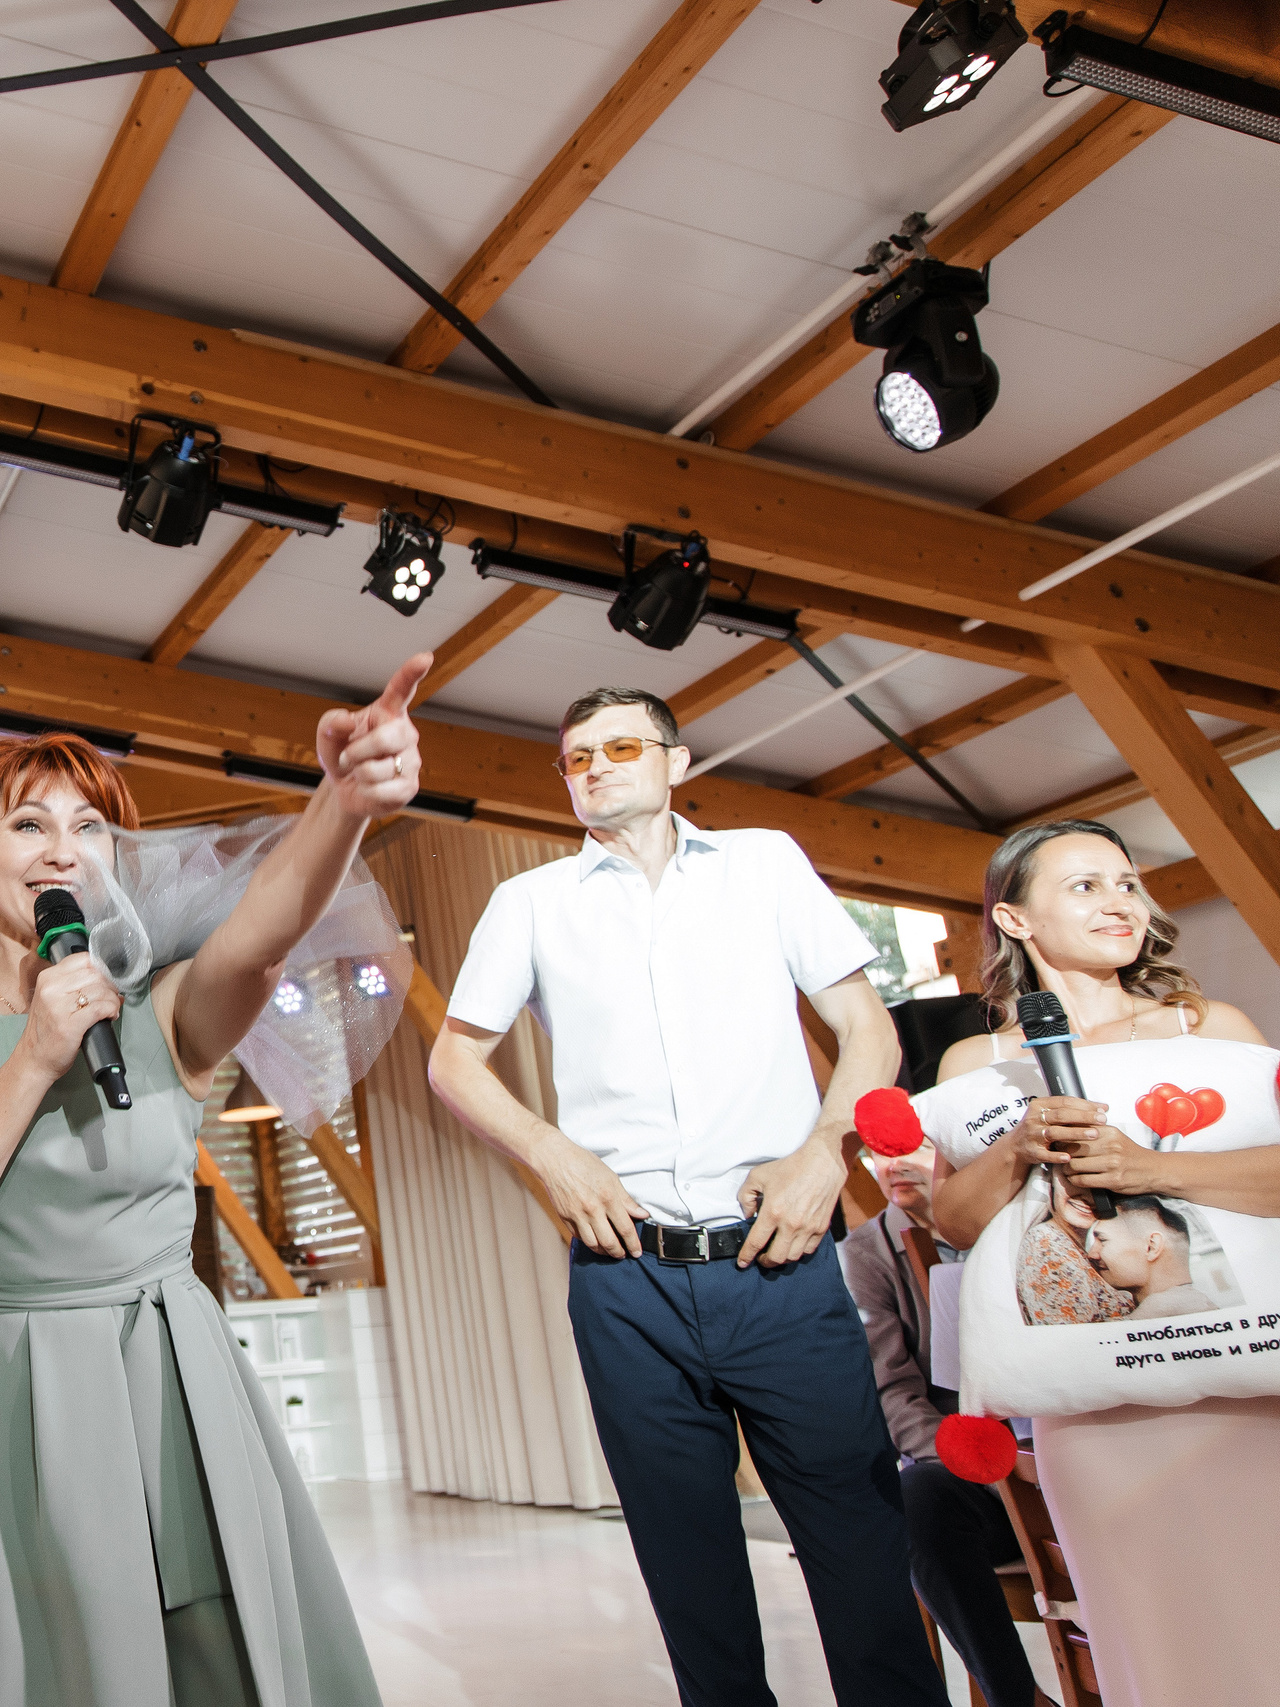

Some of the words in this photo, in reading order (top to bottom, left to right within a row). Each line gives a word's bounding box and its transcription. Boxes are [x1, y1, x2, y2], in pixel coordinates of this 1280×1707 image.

[965, 1104, 1009, 1137] Любовь
[1127, 1321, 1233, 1343] влюбляться
[1239, 1318, 1251, 1330] в
[1115, 1353, 1166, 1370] друга
[1171, 1348, 1223, 1362] вновь
[1228, 1344, 1243, 1356] и
[1249, 1338, 1280, 1354] вно
